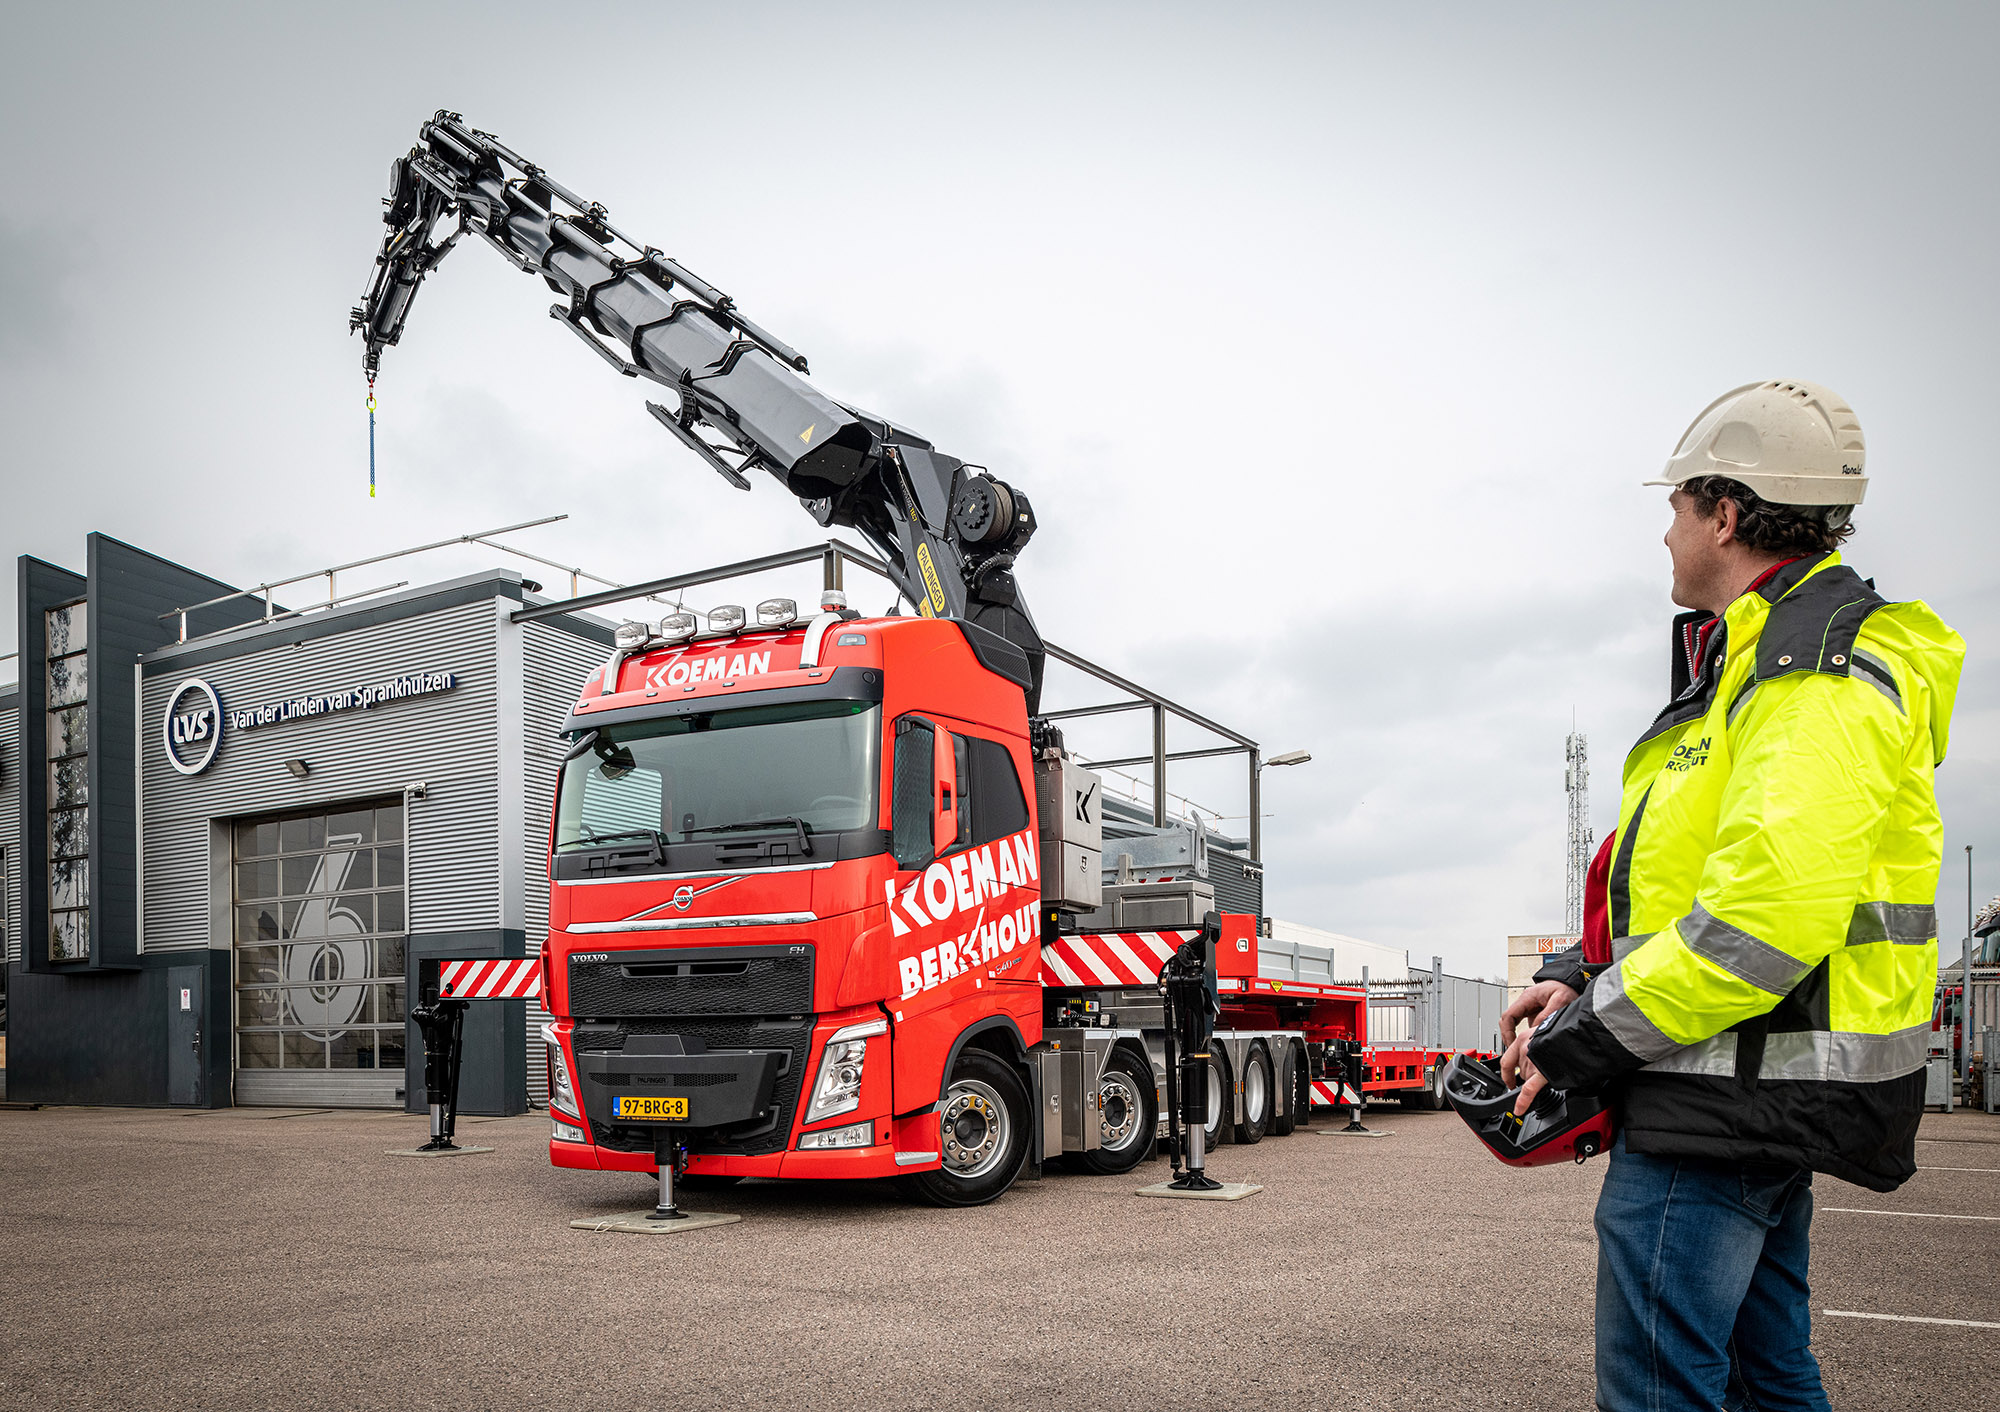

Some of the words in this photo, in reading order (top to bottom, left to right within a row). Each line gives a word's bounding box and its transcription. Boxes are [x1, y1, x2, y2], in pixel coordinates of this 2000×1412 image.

[919, 547, 944, 608] PALFINGER
[644, 651, 772, 690] KOEMAN
[231, 710, 254, 729] Van
[256, 704, 279, 724] der
[280, 696, 324, 721] Linden
[326, 690, 352, 711] van
[354, 672, 451, 708] Sprankhuizen
[173, 711, 211, 744] LVS
[885, 830, 1038, 938] KOEMAN
[284, 833, 371, 1043] 6
[572, 953, 608, 962] VOLVO
[898, 899, 1041, 1001] BERKHOUT
[995, 960, 1012, 975] 540
[624, 1099, 683, 1115] 97-BRG-8
